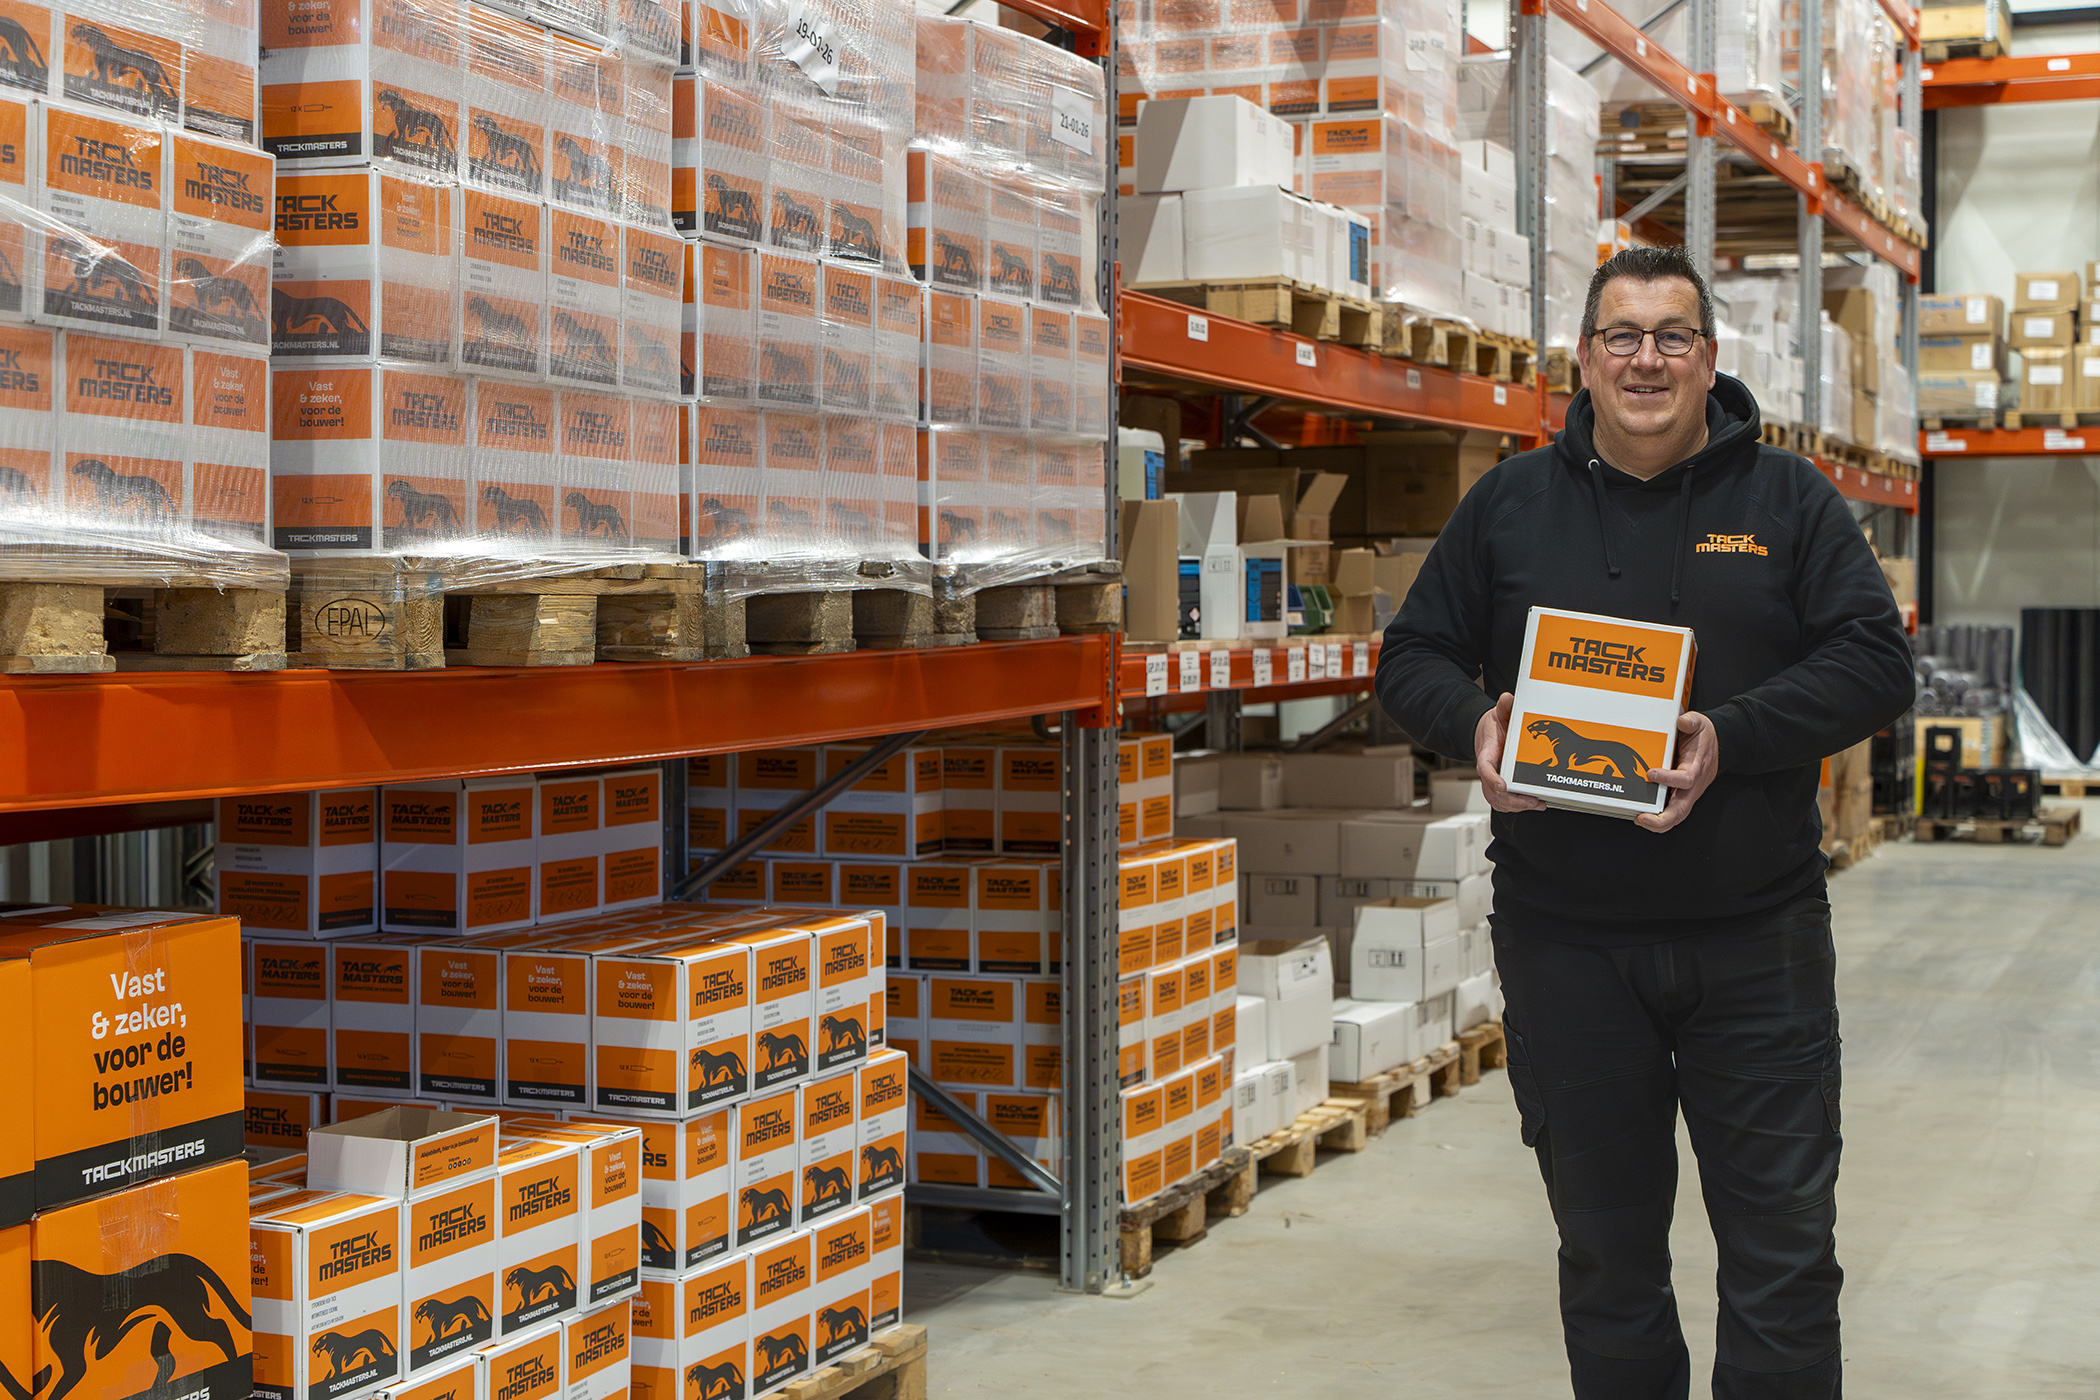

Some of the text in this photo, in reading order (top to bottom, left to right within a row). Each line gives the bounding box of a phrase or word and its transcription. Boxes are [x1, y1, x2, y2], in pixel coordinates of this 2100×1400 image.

[298, 0, 332, 12] zeker,
[289, 12, 330, 24] voor de
[288, 23, 333, 35] bouwer!
[796, 18, 834, 65] 19-01-26
[1060, 114, 1090, 140] 21-01-26
[75, 136, 135, 168] TACK
[276, 141, 347, 153] TACKMASTERS
[60, 154, 152, 190] MASTERS
[196, 162, 249, 191] TACK
[185, 180, 264, 214] MASTERS
[276, 194, 337, 212] TACK
[483, 211, 524, 236] TACK
[474, 228, 534, 256] MASTERS
[568, 231, 604, 253] TACK
[560, 246, 614, 273] MASTERS
[640, 247, 670, 270] TACK
[632, 260, 676, 286] MASTERS
[774, 270, 803, 291] TACK
[767, 284, 812, 307] MASTERS
[836, 282, 862, 302] TACK
[71, 302, 133, 318] TACKMASTERS.NL
[830, 294, 869, 318] MASTERS
[192, 319, 245, 335] TACKMASTERS.NL
[94, 359, 154, 385] TACK
[220, 366, 238, 380] Vast
[79, 378, 172, 406] MASTERS
[214, 378, 246, 394] & zeker,
[310, 382, 332, 392] Vast
[214, 394, 244, 405] voor de
[300, 394, 342, 406] & zeker,
[403, 391, 444, 410] TACK
[214, 404, 246, 418] bouwer!
[300, 406, 341, 416] voor de
[392, 409, 458, 431] MASTERS
[495, 402, 534, 421] TACK
[577, 410, 613, 429] TACK
[300, 416, 344, 428] bouwer!
[486, 416, 546, 439] MASTERS
[568, 426, 624, 448] MASTERS
[712, 424, 742, 444] TACK
[704, 438, 753, 456] MASTERS
[288, 534, 358, 542] TACKMASTERS
[1707, 534, 1755, 544] TACK
[1696, 543, 1768, 557] MASTERS
[328, 608, 373, 636] EPAL
[1570, 636, 1647, 662] TACK
[1548, 651, 1666, 683] MASTERS
[1546, 773, 1625, 794] TACKMASTERS.NL
[238, 804, 272, 816] TACK
[326, 806, 354, 818] TACK
[391, 804, 428, 816] TACK
[482, 803, 508, 814] TACK
[482, 812, 522, 824] MASTERS
[238, 814, 292, 827] MASTERS
[326, 815, 370, 827] MASTERS
[391, 814, 450, 826] MASTERS
[831, 943, 858, 960] TACK
[261, 958, 299, 970] TACK
[342, 962, 380, 973] TACK
[448, 960, 467, 970] Vast
[536, 965, 554, 976] Vast
[768, 956, 798, 974] TACK
[826, 954, 865, 976] MASTERS
[110, 968, 165, 1000] Vast
[261, 969, 320, 982] MASTERS
[342, 971, 402, 984] MASTERS
[442, 980, 474, 989] voor de
[538, 974, 562, 986] zeker,
[626, 971, 645, 981] Vast
[702, 970, 735, 989] TACK
[762, 968, 806, 991] MASTERS
[441, 988, 476, 1000] bouwer!
[528, 985, 561, 994] voor de
[628, 980, 653, 992] zeker,
[696, 980, 743, 1006] MASTERS
[528, 994, 564, 1005] bouwer!
[618, 1000, 655, 1010] bouwer!
[620, 992, 652, 1000] voor de
[92, 1002, 187, 1040] & zeker,
[94, 1032, 186, 1074] voor de
[767, 1066, 798, 1081] TACKMASTERS.NL
[870, 1073, 896, 1092] TACK
[93, 1061, 193, 1112] bouwer!
[431, 1080, 486, 1091] TACKMASTERS
[518, 1087, 575, 1098] TACKMASTERS
[702, 1086, 734, 1100] TACKMASTERS.NL
[608, 1094, 666, 1105] TACKMASTERS
[815, 1090, 844, 1110] TACK
[865, 1084, 902, 1108] MASTERS
[753, 1110, 782, 1130] TACK
[810, 1102, 850, 1126] MASTERS
[700, 1126, 714, 1136] Vast
[746, 1120, 790, 1143] MASTERS
[609, 1150, 622, 1163] Vast
[696, 1151, 718, 1166] bouwer!
[697, 1144, 717, 1156] voor de
[82, 1138, 205, 1186] TACKMASTERS
[612, 1162, 626, 1174] zeker,
[604, 1172, 626, 1184] voor de
[604, 1180, 626, 1195] bouwer!
[518, 1176, 560, 1202] TACK
[510, 1191, 571, 1222] MASTERS
[430, 1203, 474, 1230] TACK
[330, 1230, 378, 1260] TACK
[420, 1220, 486, 1253] MASTERS
[828, 1231, 856, 1251] TACK
[691, 1242, 724, 1260] TACKMASTERS
[822, 1242, 865, 1270] MASTERS
[253, 1264, 266, 1274] de
[320, 1244, 392, 1282] MASTERS
[767, 1255, 796, 1276] TACK
[596, 1276, 632, 1294] TACKMASTERS
[760, 1266, 805, 1296] MASTERS
[698, 1280, 732, 1302] TACK
[518, 1302, 560, 1323] TACKMASTERS.NL
[639, 1310, 650, 1318] de
[690, 1293, 741, 1324] MASTERS
[582, 1322, 616, 1344] TACK
[429, 1334, 474, 1358] TACKMASTERS.NL
[576, 1332, 624, 1369] MASTERS
[506, 1354, 544, 1378] TACK
[329, 1370, 378, 1393] TACKMASTERS.NL
[498, 1370, 554, 1400] MASTERS
